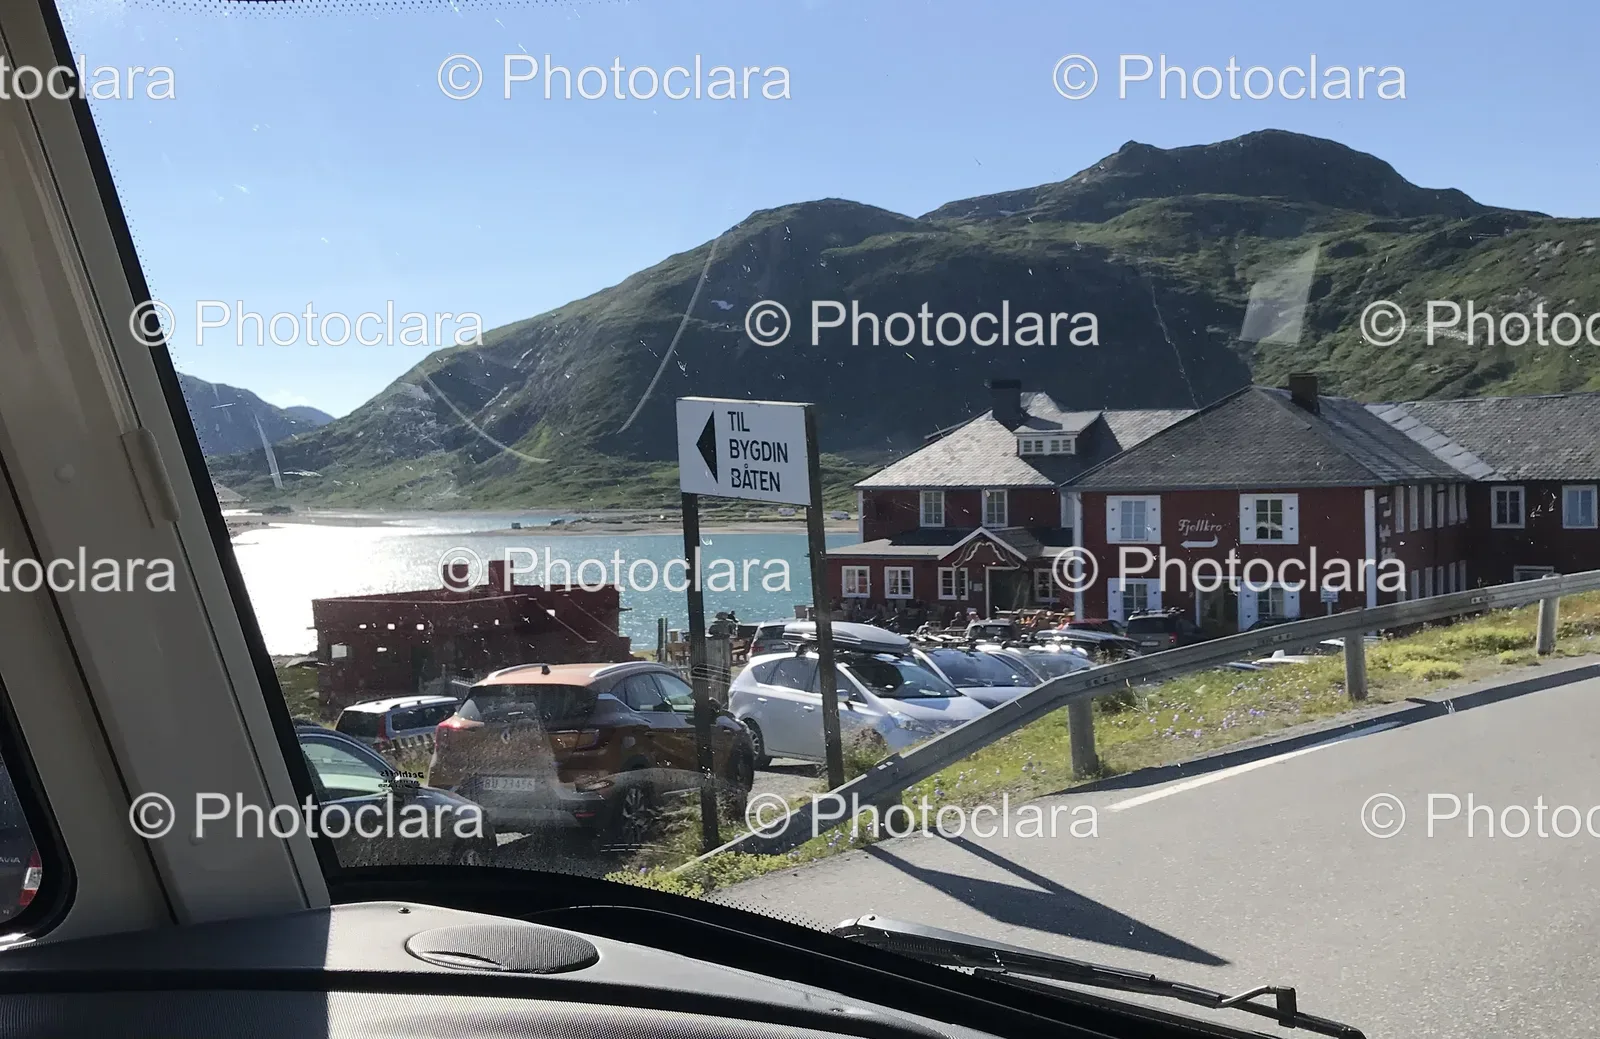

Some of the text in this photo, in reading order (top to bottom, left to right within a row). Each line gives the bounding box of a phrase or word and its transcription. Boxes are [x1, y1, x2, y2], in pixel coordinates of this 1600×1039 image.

[727, 411, 750, 432] TIL
[729, 438, 789, 463] BYGDIN
[731, 463, 781, 493] BÅTEN
